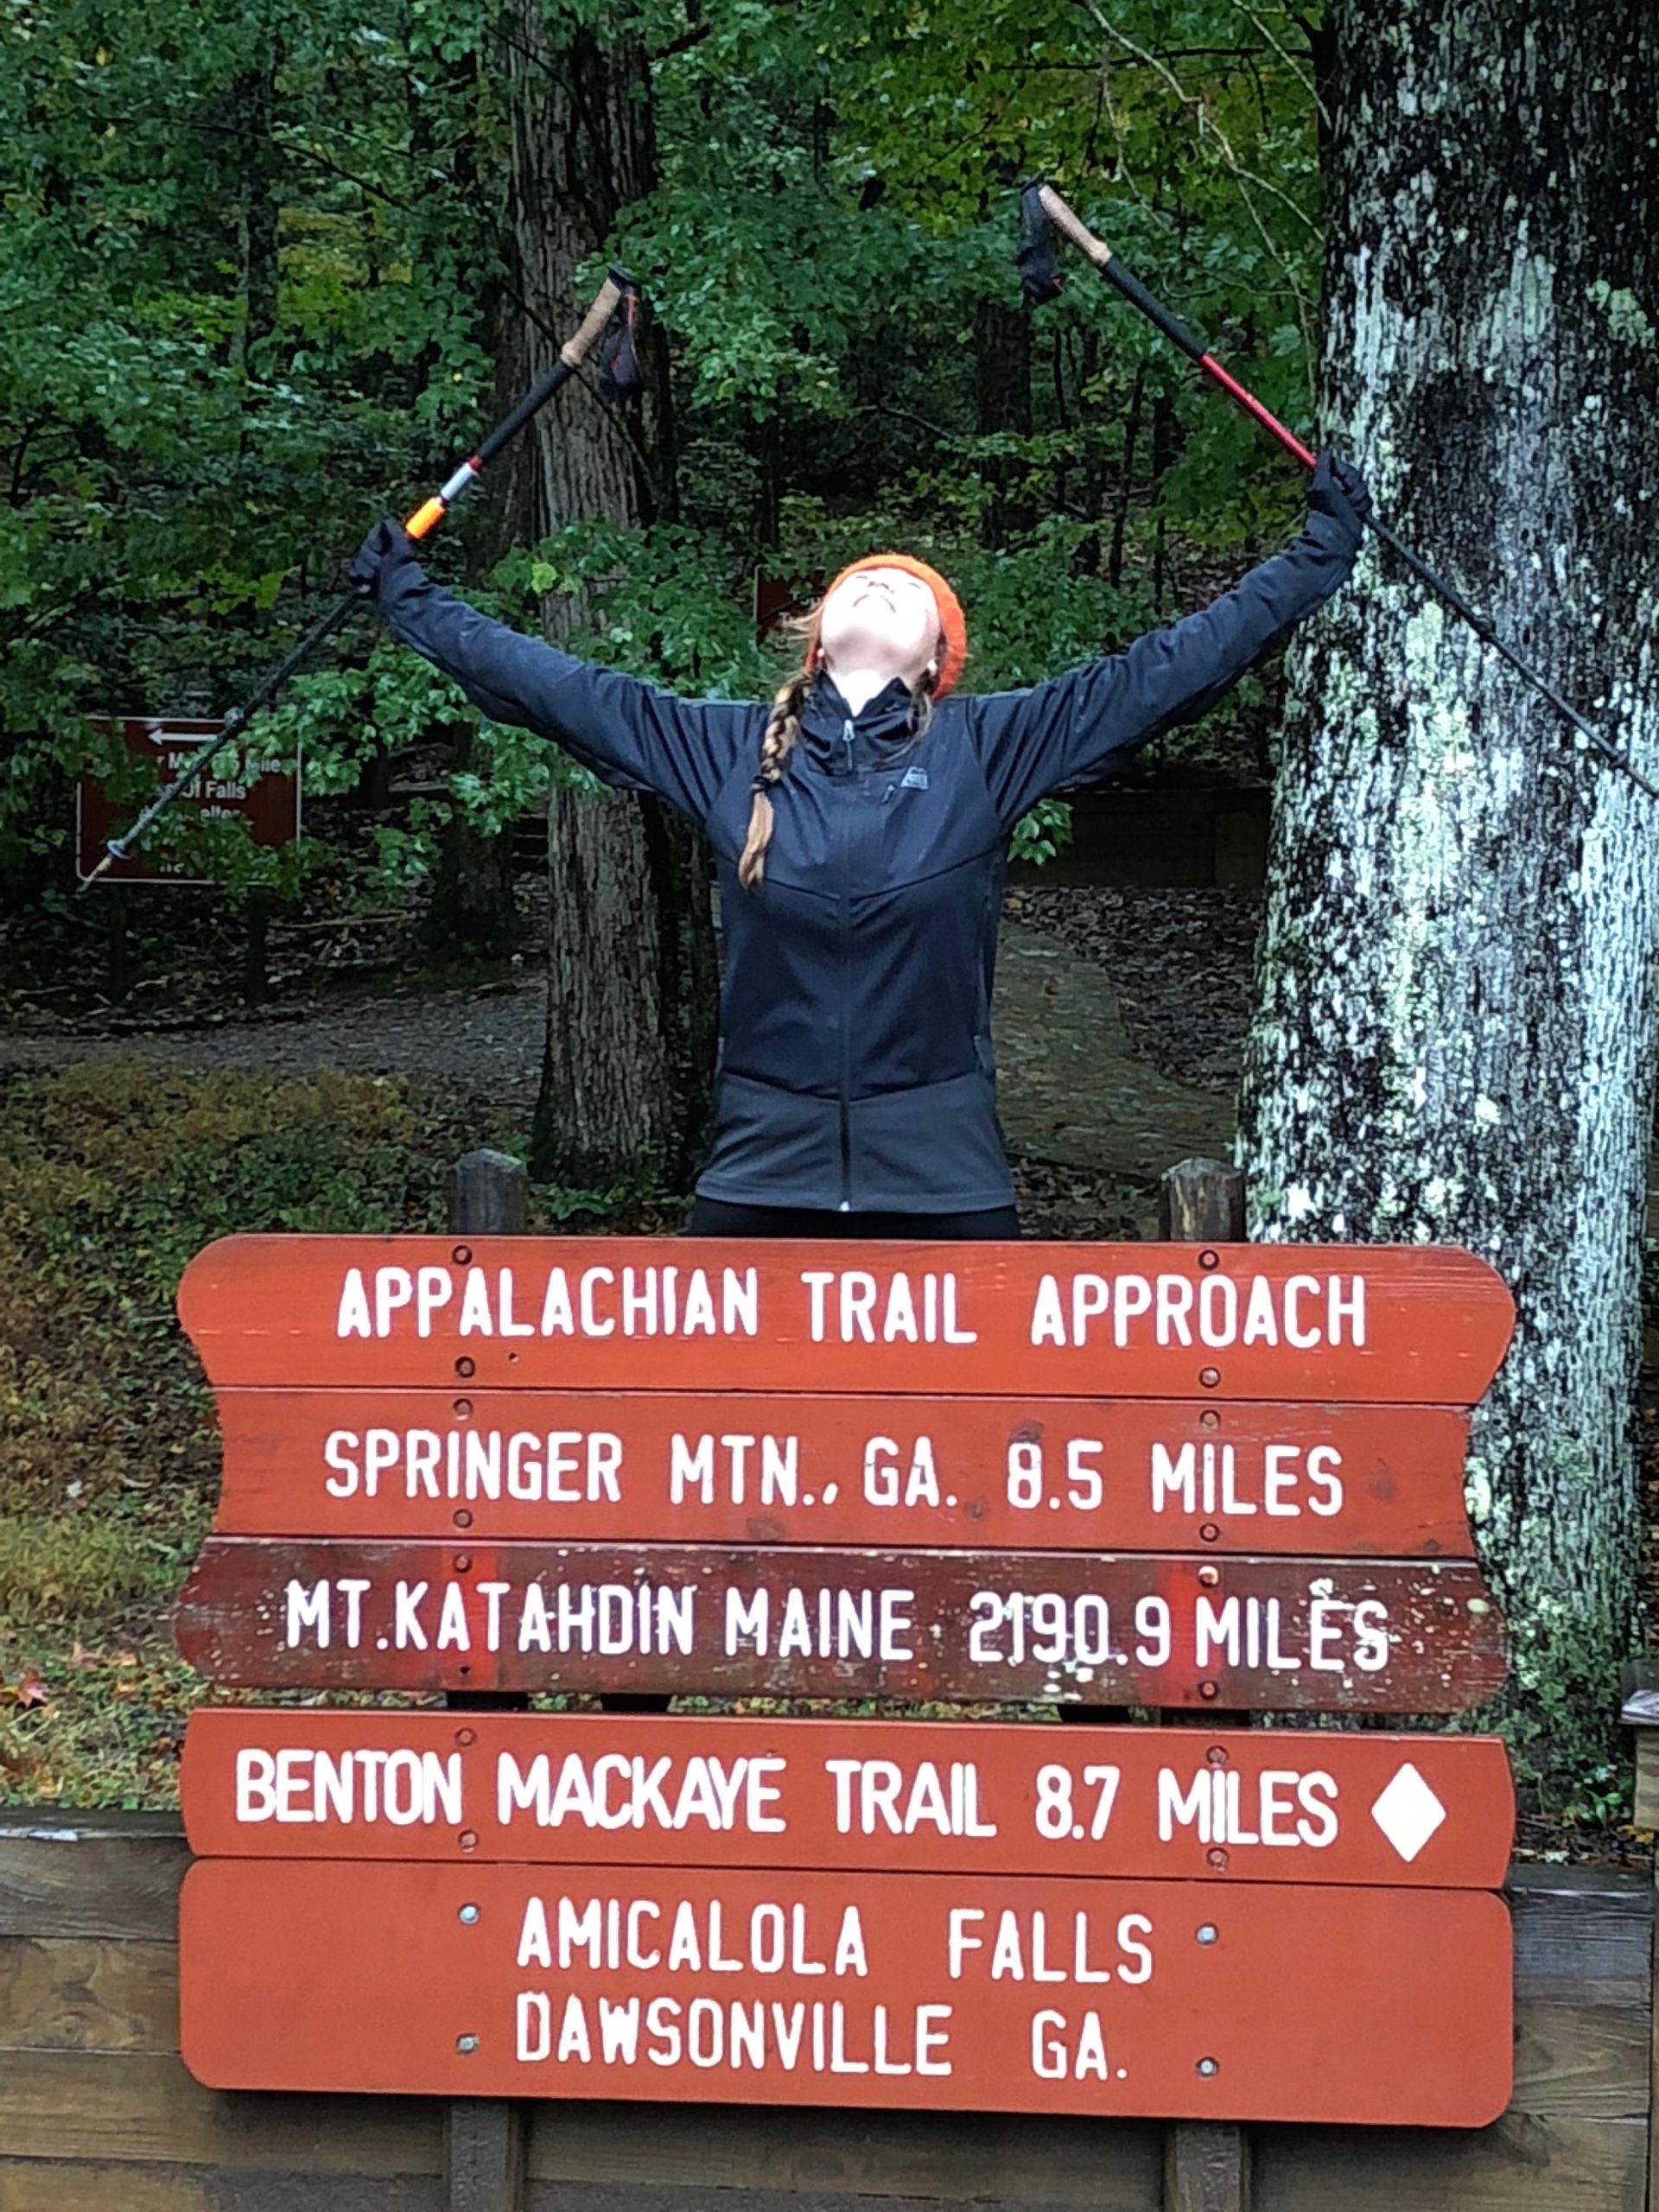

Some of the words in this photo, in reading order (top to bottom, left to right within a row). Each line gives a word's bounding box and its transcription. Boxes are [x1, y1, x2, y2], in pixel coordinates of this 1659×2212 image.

[205, 780, 247, 800] Falls
[337, 1266, 758, 1338] APPALACHIAN
[800, 1270, 978, 1344] TRAIL
[1031, 1274, 1366, 1349] APPROACH
[324, 1428, 623, 1503] SPRINGER
[863, 1436, 957, 1507] GA.
[1007, 1439, 1103, 1510] 8.5
[1151, 1442, 1343, 1516] MILES
[725, 1586, 915, 1662] MAINE
[969, 1592, 1172, 1668] 2190.9
[1195, 1595, 1390, 1672] MILES
[236, 1748, 462, 1826] BENTON
[497, 1751, 787, 1833] MACKAYE
[825, 1759, 997, 1837] TRAIL
[1035, 1764, 1121, 1840] 8.7
[1157, 1768, 1338, 1847] MILES
[517, 1896, 868, 1977] AMICALOLA
[948, 1908, 1153, 1985] FALLS
[517, 1991, 952, 2075] DAWSONVILLE
[1032, 2009, 1128, 2081] GA.
